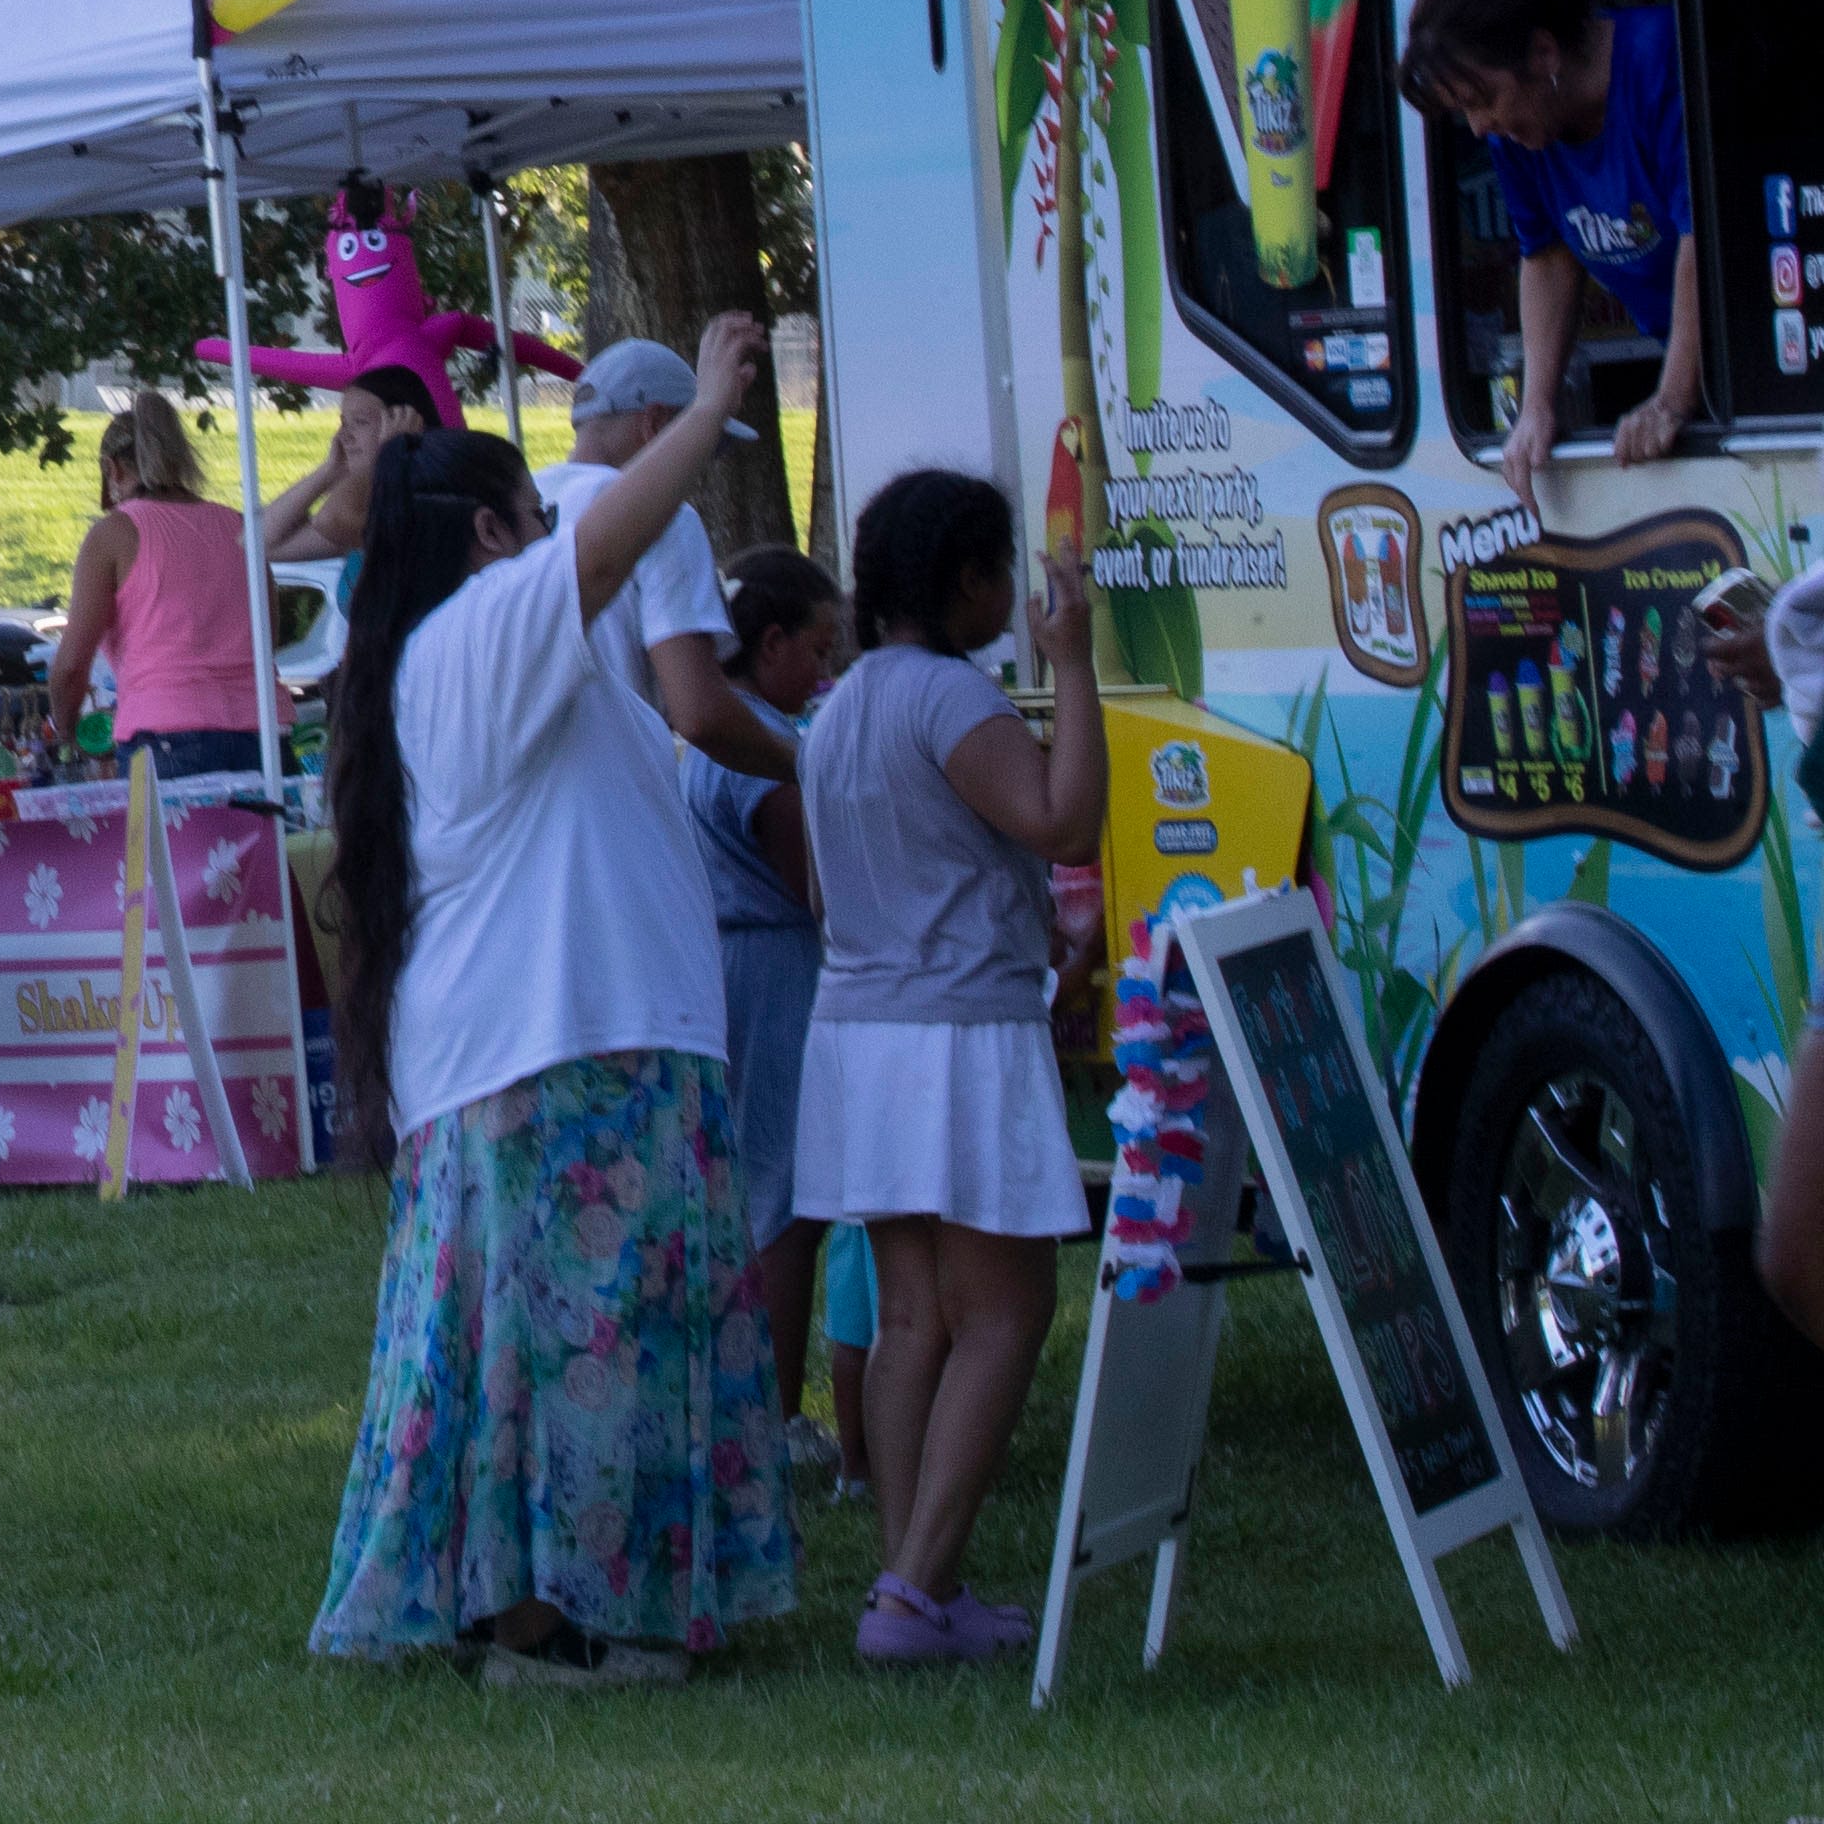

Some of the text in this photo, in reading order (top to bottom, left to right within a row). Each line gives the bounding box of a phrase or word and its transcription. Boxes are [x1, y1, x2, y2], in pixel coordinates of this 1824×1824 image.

[1124, 396, 1231, 453] Invite us to
[1104, 464, 1263, 532] your next party,
[1093, 529, 1288, 592] event, or fundraiser!
[1440, 506, 1540, 575] Menu
[1469, 569, 1528, 592] Shaved
